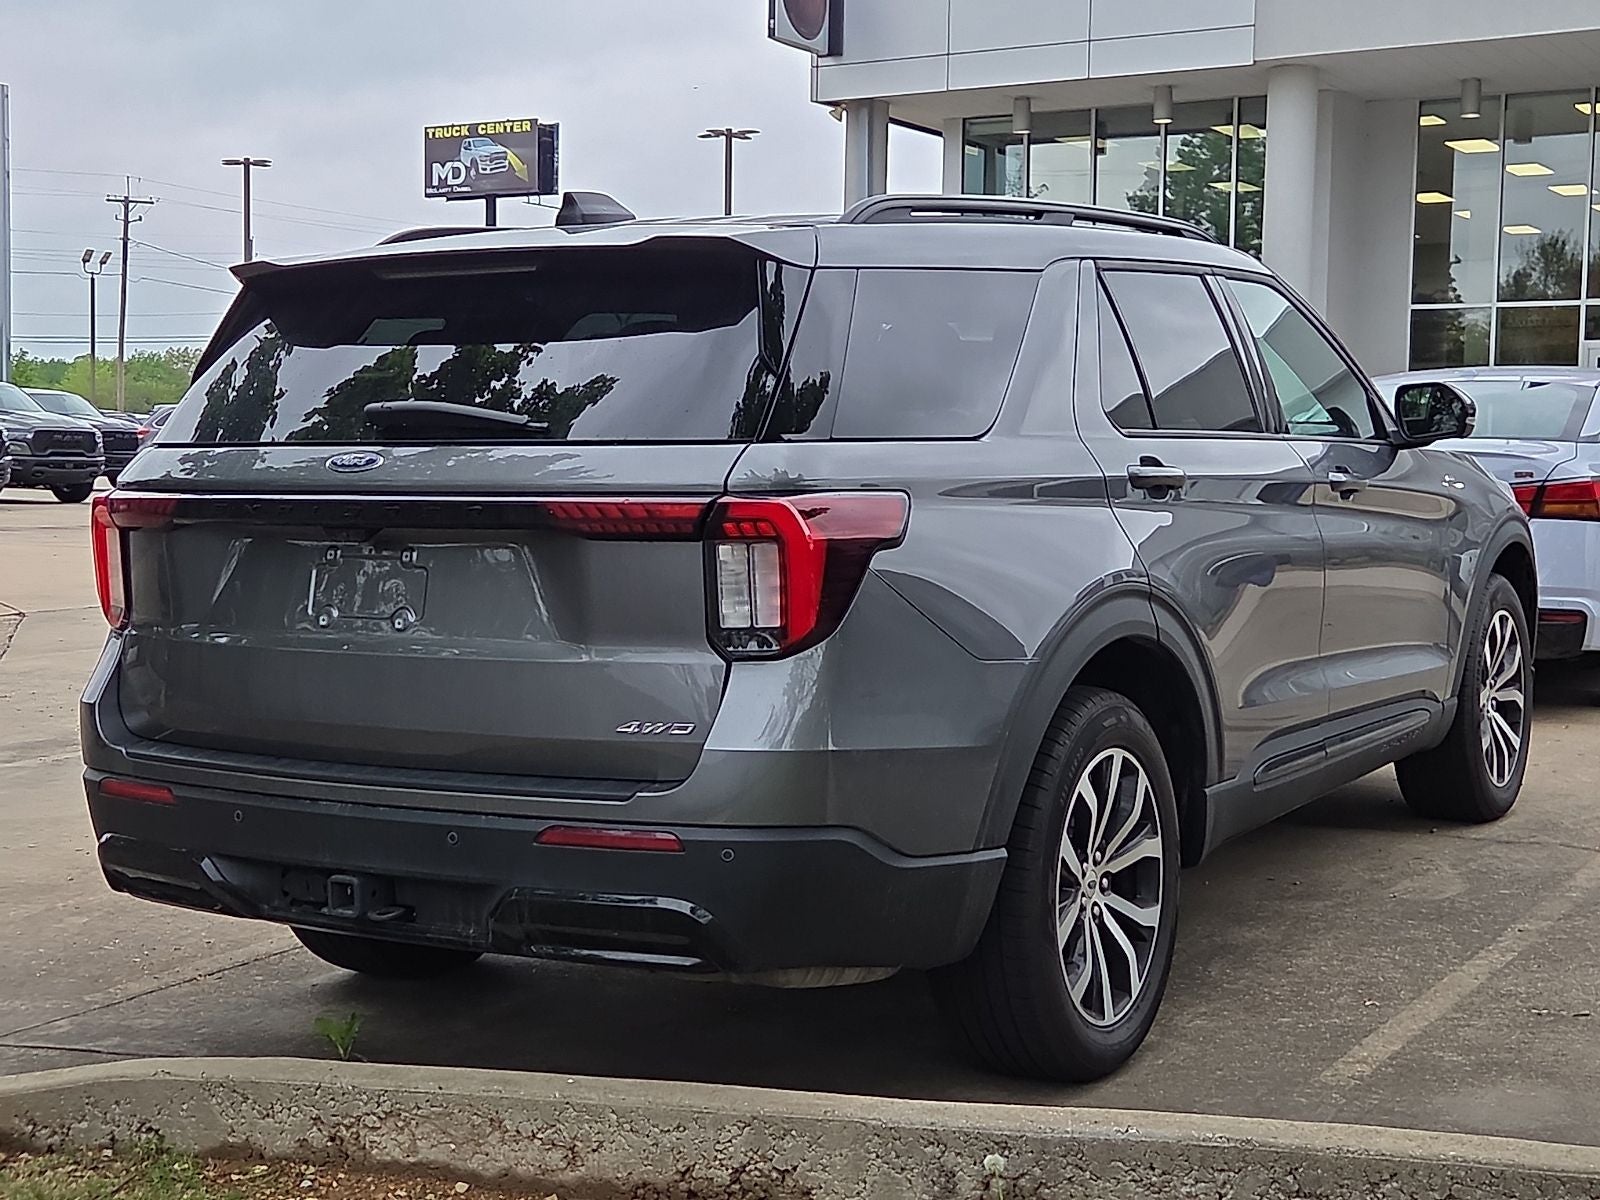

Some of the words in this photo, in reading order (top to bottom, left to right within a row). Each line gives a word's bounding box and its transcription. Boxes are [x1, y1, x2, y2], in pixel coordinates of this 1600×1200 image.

[426, 125, 470, 139] TRUCK
[478, 120, 532, 135] CENTER
[431, 161, 467, 186] MD
[329, 452, 382, 469] Ford
[615, 720, 697, 735] 4WD
